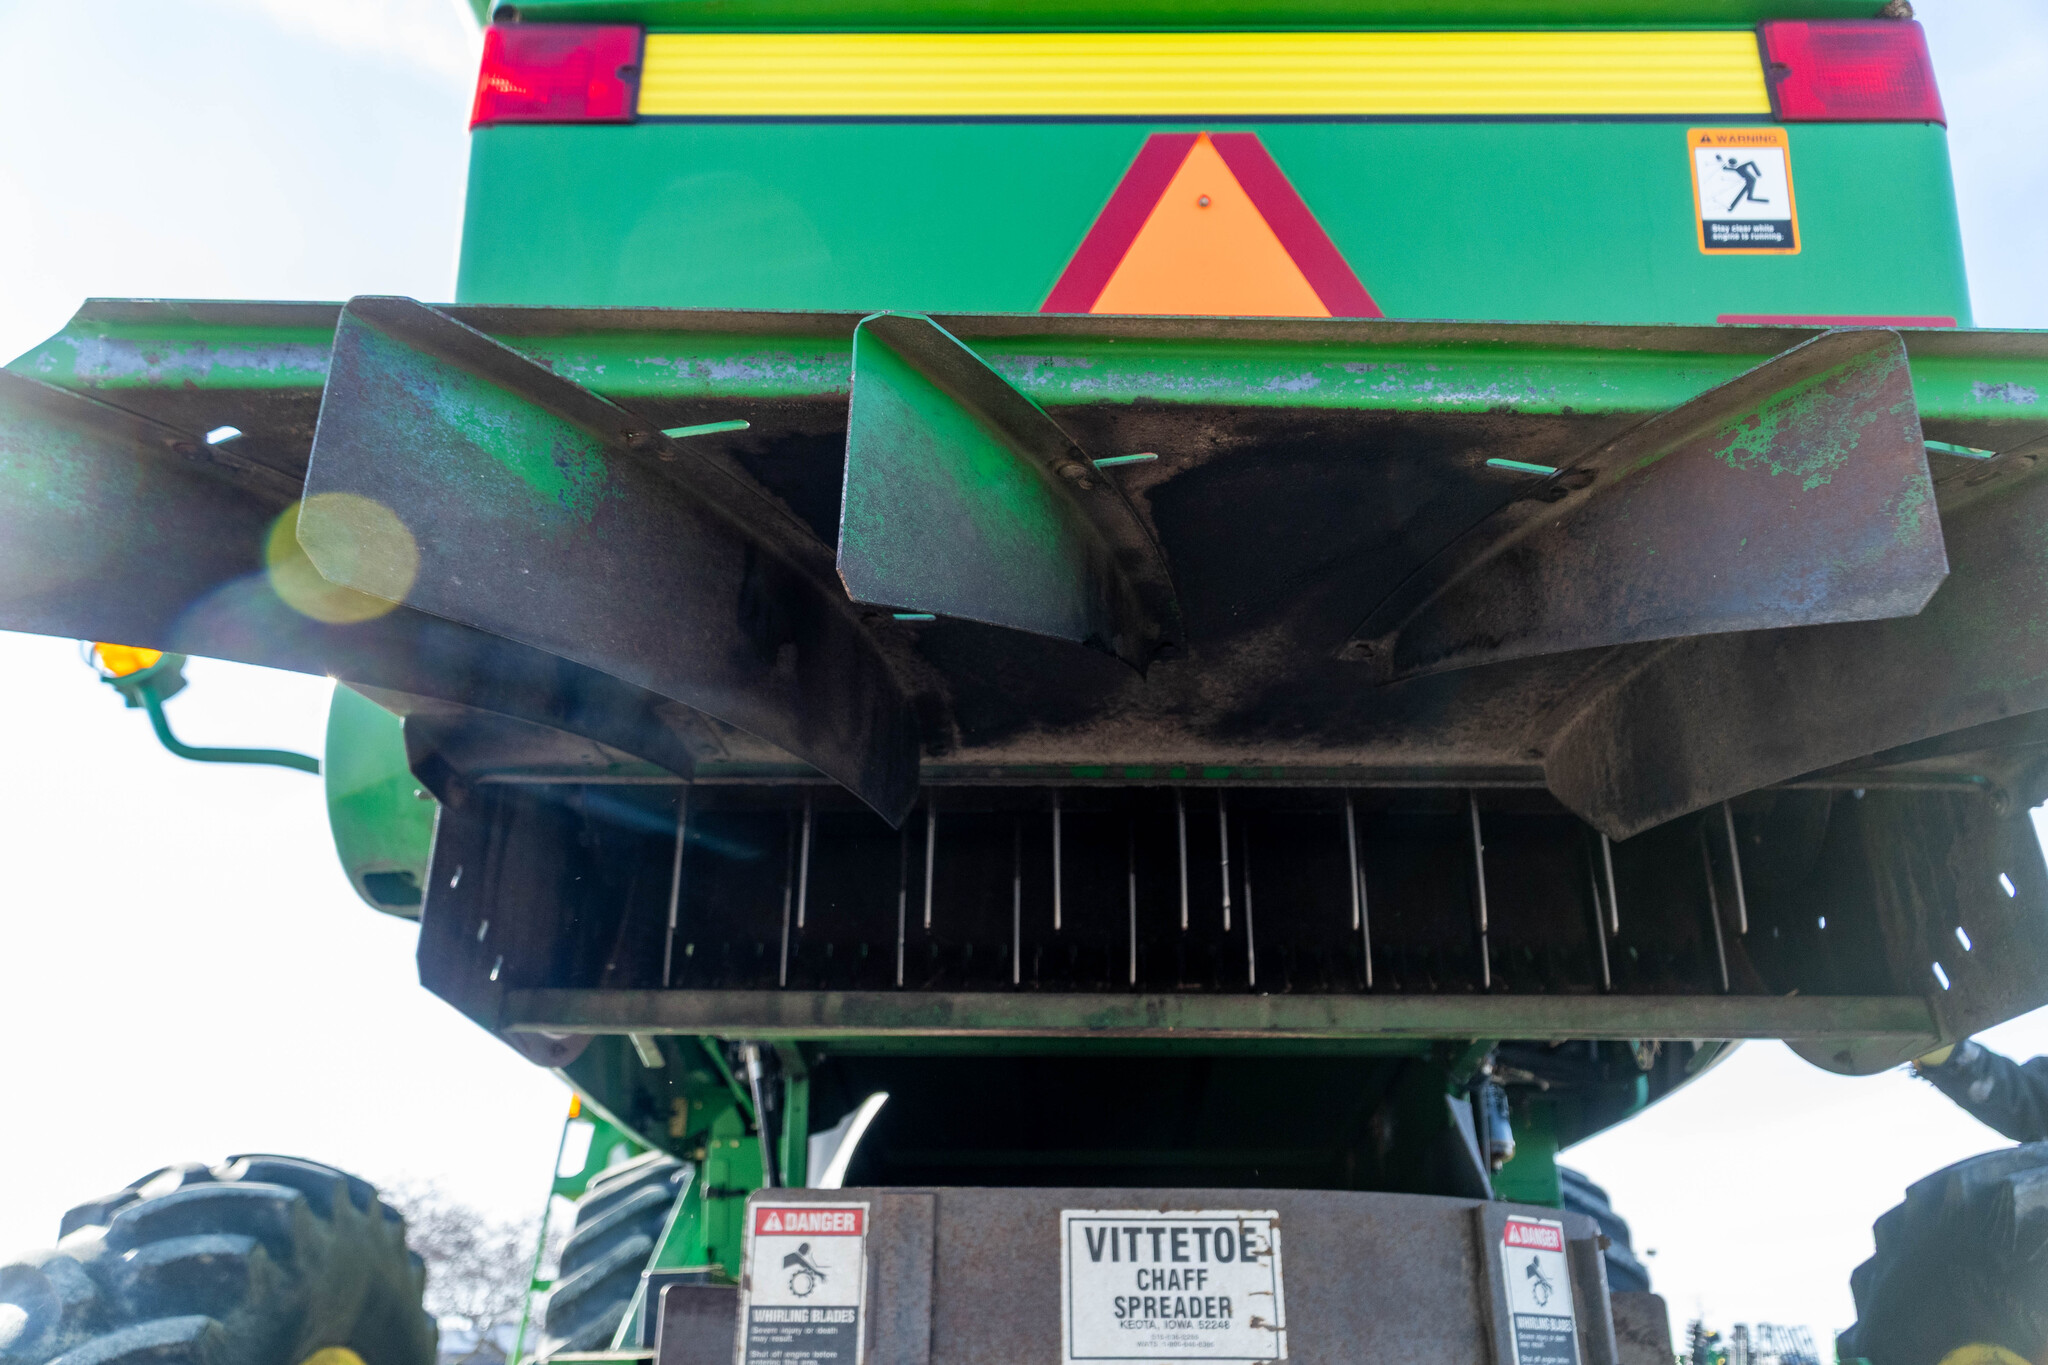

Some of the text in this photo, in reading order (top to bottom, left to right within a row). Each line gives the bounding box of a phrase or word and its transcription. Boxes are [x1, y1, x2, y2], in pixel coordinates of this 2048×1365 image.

[1716, 135, 1777, 143] WARNING
[1712, 224, 1774, 234] Stay clear while
[1712, 232, 1784, 242] engine is running.
[784, 1212, 856, 1232] DANGER
[1519, 1226, 1560, 1248] DANGER
[1084, 1226, 1259, 1263] VITTETOE
[1137, 1268, 1208, 1291] CHAFF
[1114, 1296, 1233, 1319] SPREADER
[752, 1309, 856, 1323] WHIRLING BLADES
[1120, 1320, 1231, 1331] KEOTA, IOWA 52248
[1516, 1316, 1550, 1331] WHIRLING
[751, 1326, 778, 1334] Severe
[780, 1326, 802, 1336] injury
[816, 1326, 838, 1334] death
[752, 1336, 768, 1344] may
[750, 1350, 838, 1360] Shut off engine before
